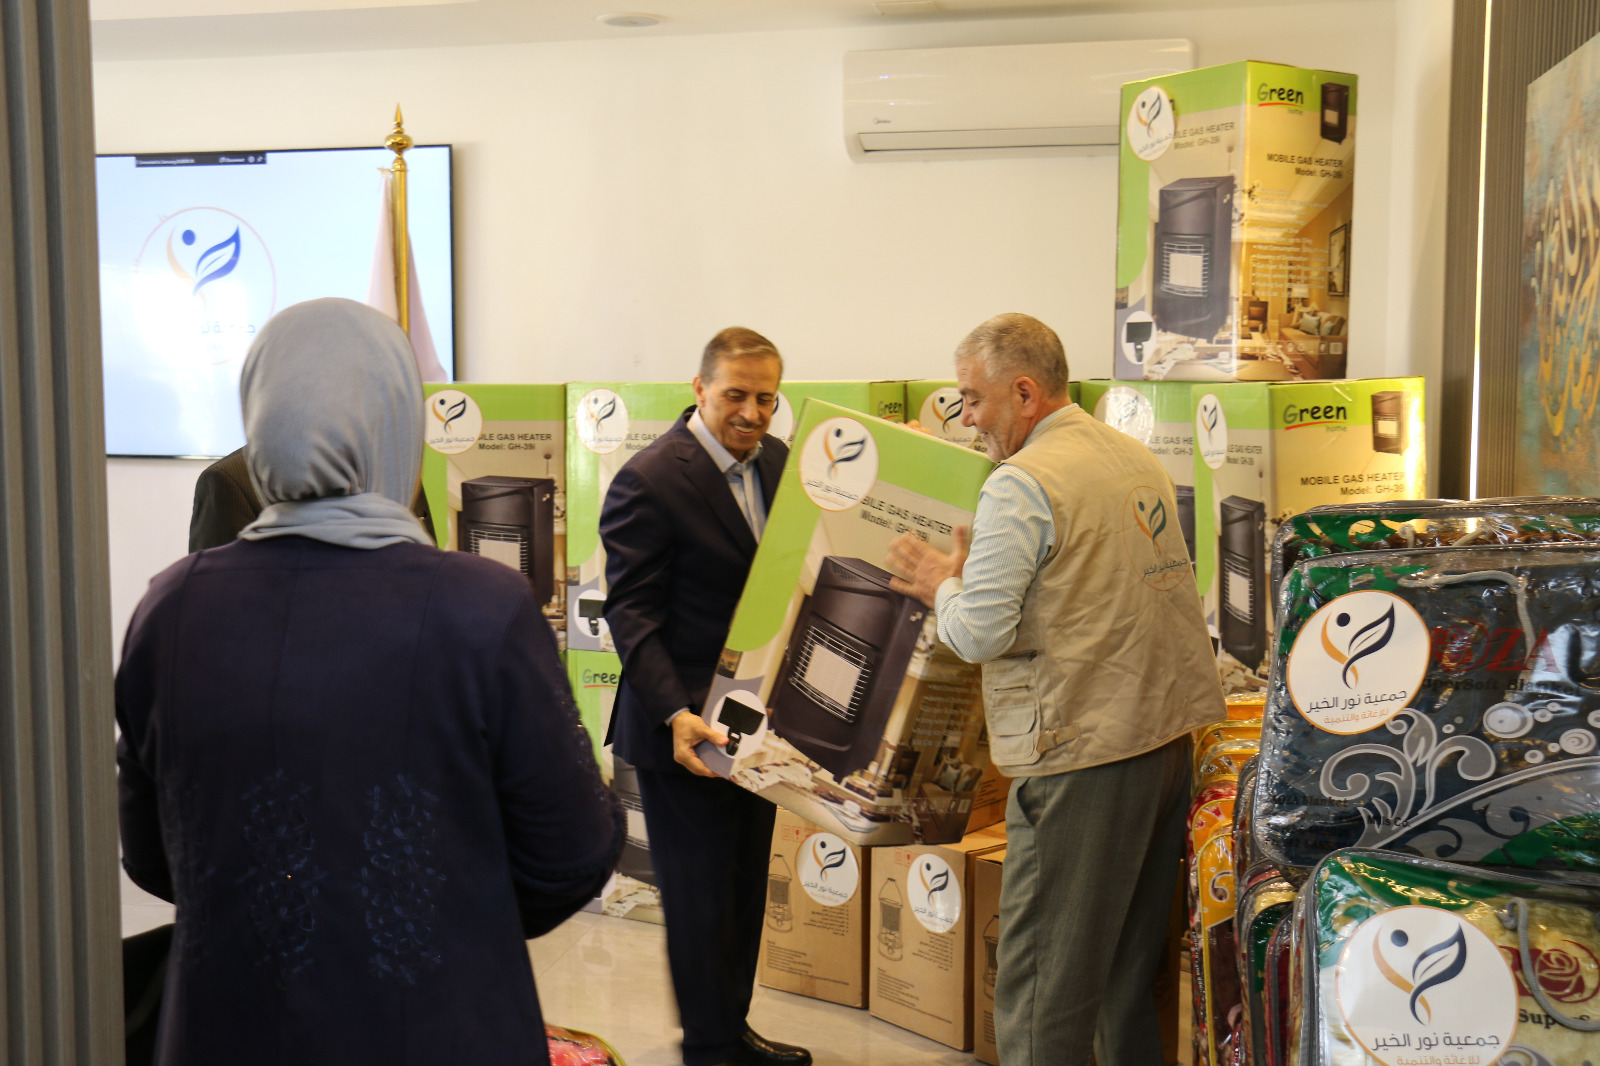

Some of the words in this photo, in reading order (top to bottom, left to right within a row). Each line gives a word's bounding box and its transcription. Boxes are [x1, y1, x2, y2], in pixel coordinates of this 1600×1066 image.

[1257, 82, 1304, 105] Green
[1205, 121, 1236, 133] HEATER
[1267, 153, 1295, 164] MOBILE
[1297, 155, 1313, 165] GAS
[1314, 157, 1343, 168] HEATER
[1283, 404, 1347, 424] Green
[497, 433, 515, 441] GAS
[517, 433, 552, 441] HEATER
[641, 433, 657, 441] GAS
[1162, 436, 1181, 445] GAS
[1300, 475, 1340, 486] MOBILE
[1342, 473, 1364, 484] GAS
[1340, 486, 1373, 496] Model:
[860, 509, 893, 529] Model:
[887, 504, 911, 521] GAS
[911, 512, 953, 537] HEATER
[583, 669, 620, 685] Gree
[1306, 696, 1338, 713] الخير
[1340, 694, 1361, 710] نور
[1363, 690, 1407, 706] جمعية
[1371, 1033, 1412, 1051] الخير
[1414, 1032, 1439, 1051] نور
[1442, 1032, 1500, 1050] جمعية
